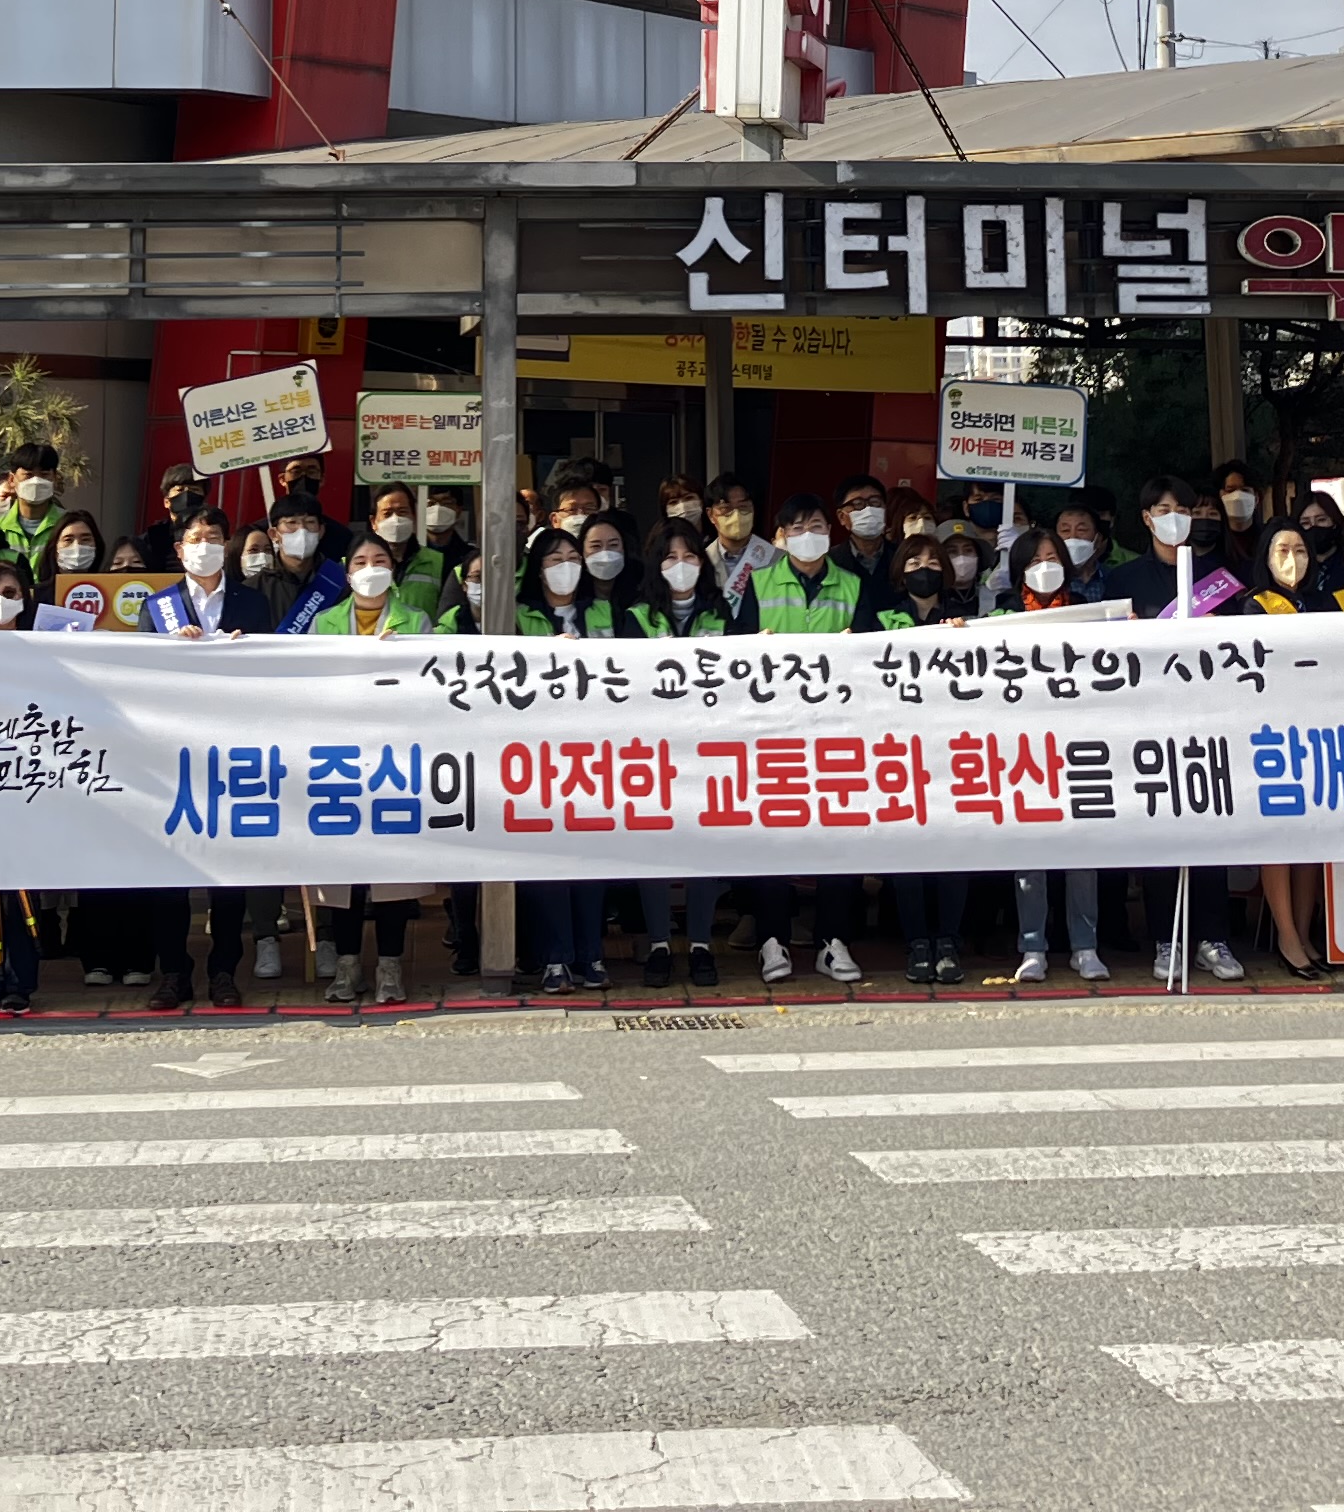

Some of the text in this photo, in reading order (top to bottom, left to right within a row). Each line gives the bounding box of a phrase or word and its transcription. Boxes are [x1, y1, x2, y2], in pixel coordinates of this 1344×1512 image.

[674, 190, 1211, 316] 신터미널
[772, 327, 787, 348] 수
[792, 325, 854, 356] 있습니다.
[198, 429, 246, 456] 실버존
[252, 414, 316, 442] 조심운전
[951, 411, 1078, 438] 양보하면 빠른길,
[361, 450, 421, 466] 휴대폰은
[949, 437, 1074, 462] 끼어들면 짜증길
[421, 637, 1274, 712] 실천하는 교통안전, 힘쎈충남의 시작
[67, 748, 123, 793] 힘
[164, 744, 288, 839] 사람
[308, 742, 475, 836] 중심의
[500, 735, 676, 834] 안전한
[696, 729, 931, 830] 교통문화
[950, 730, 1117, 825] 확산을
[1132, 734, 1235, 819] 위해
